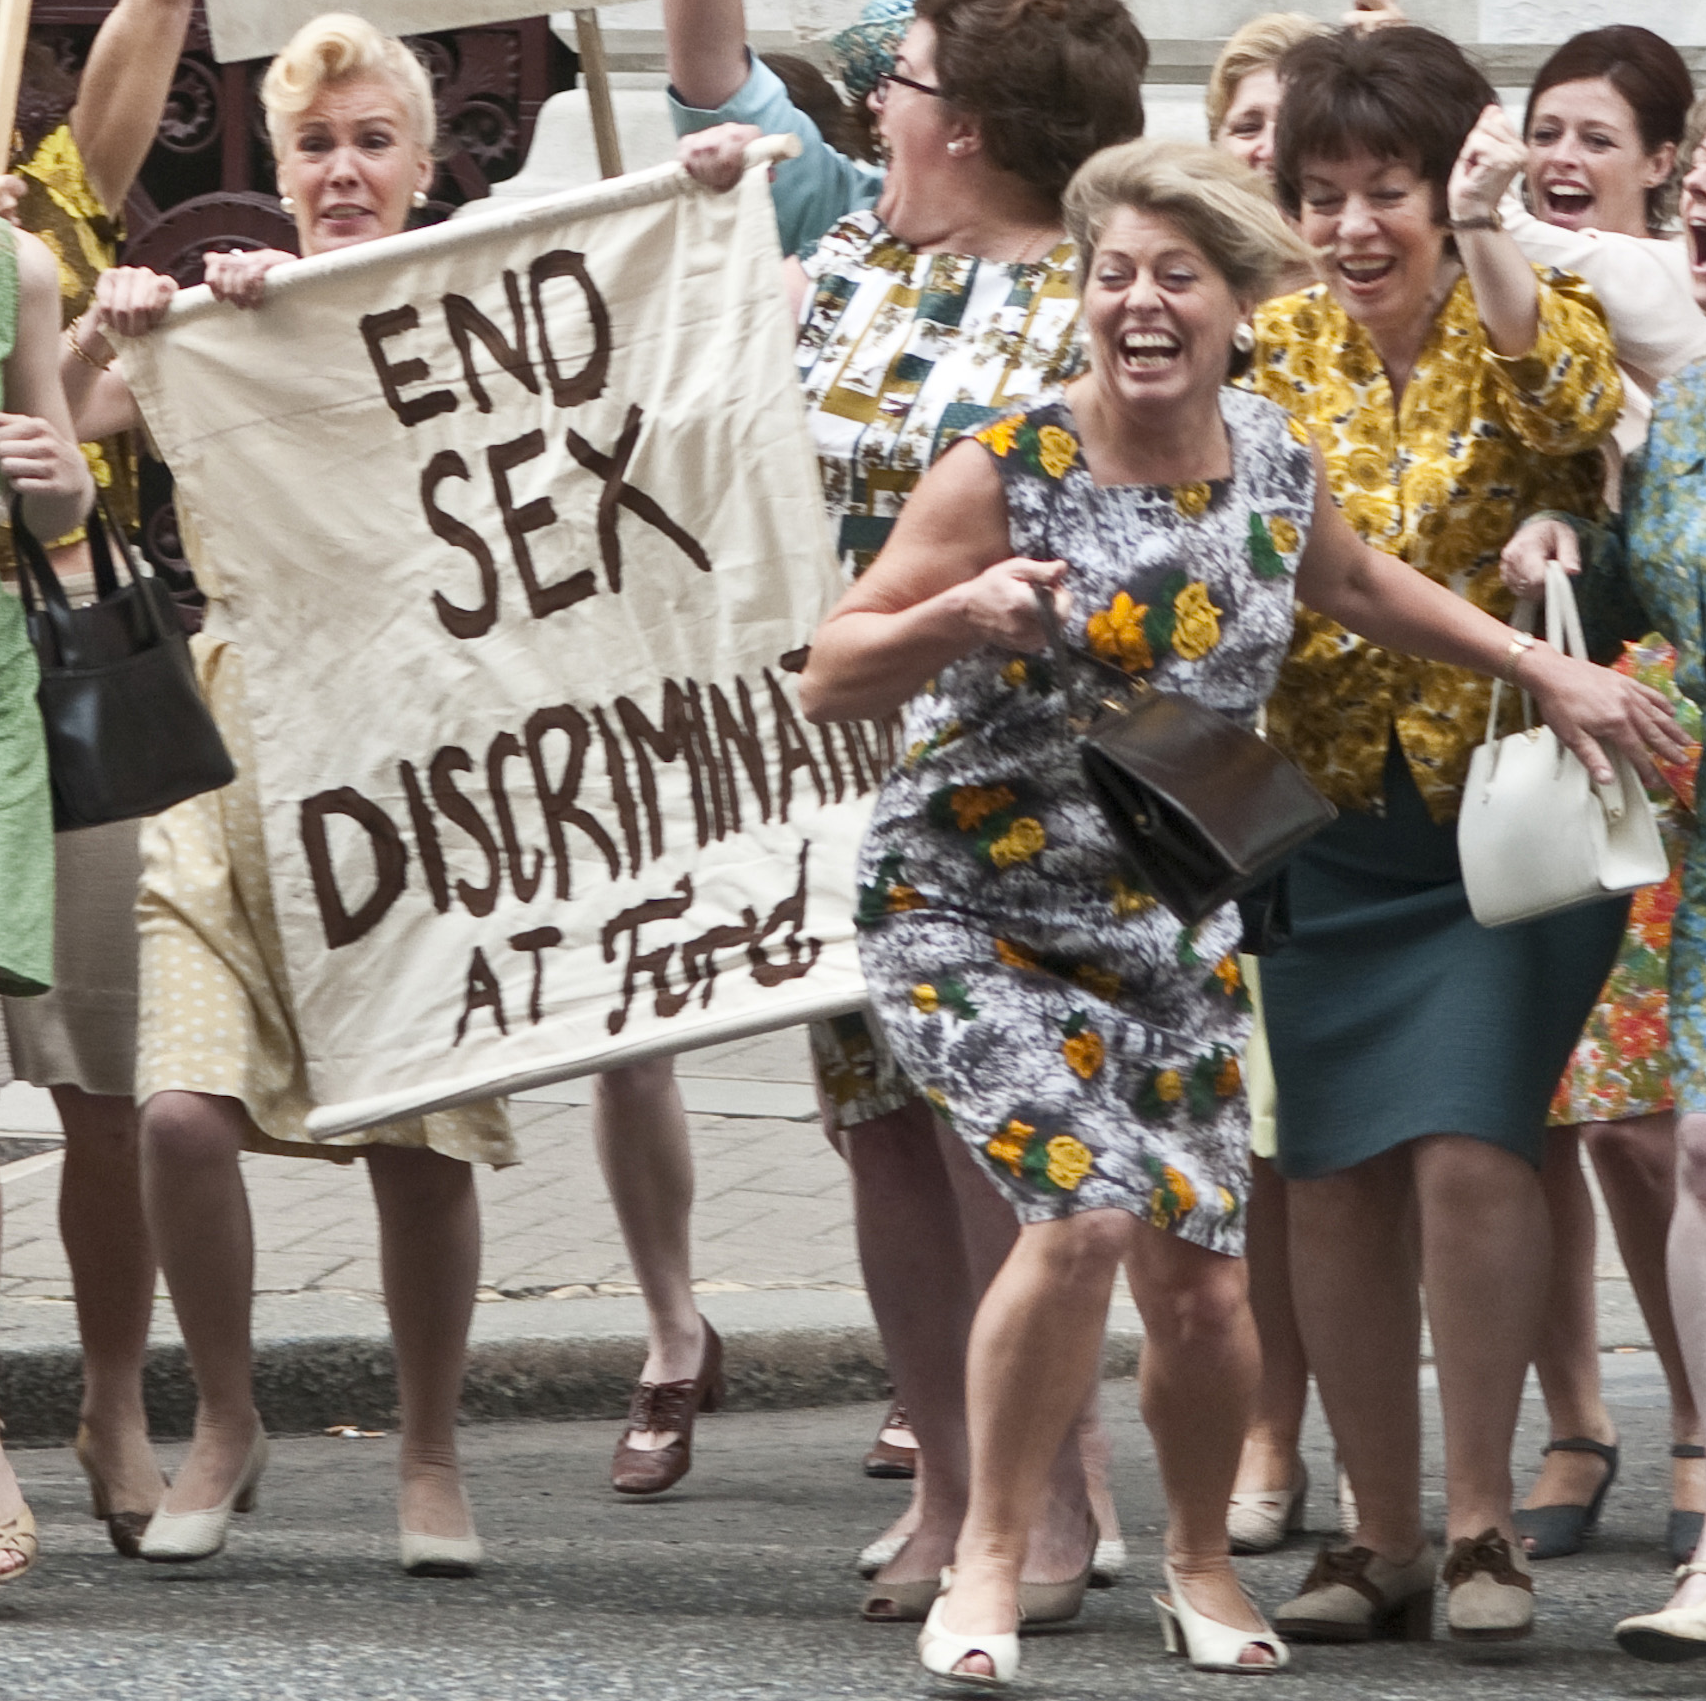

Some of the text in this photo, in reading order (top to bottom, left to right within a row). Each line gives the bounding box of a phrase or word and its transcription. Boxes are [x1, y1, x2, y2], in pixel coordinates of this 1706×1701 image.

[358, 247, 613, 428] END
[420, 401, 713, 641] SEX
[452, 837, 824, 1048] AT Ford
